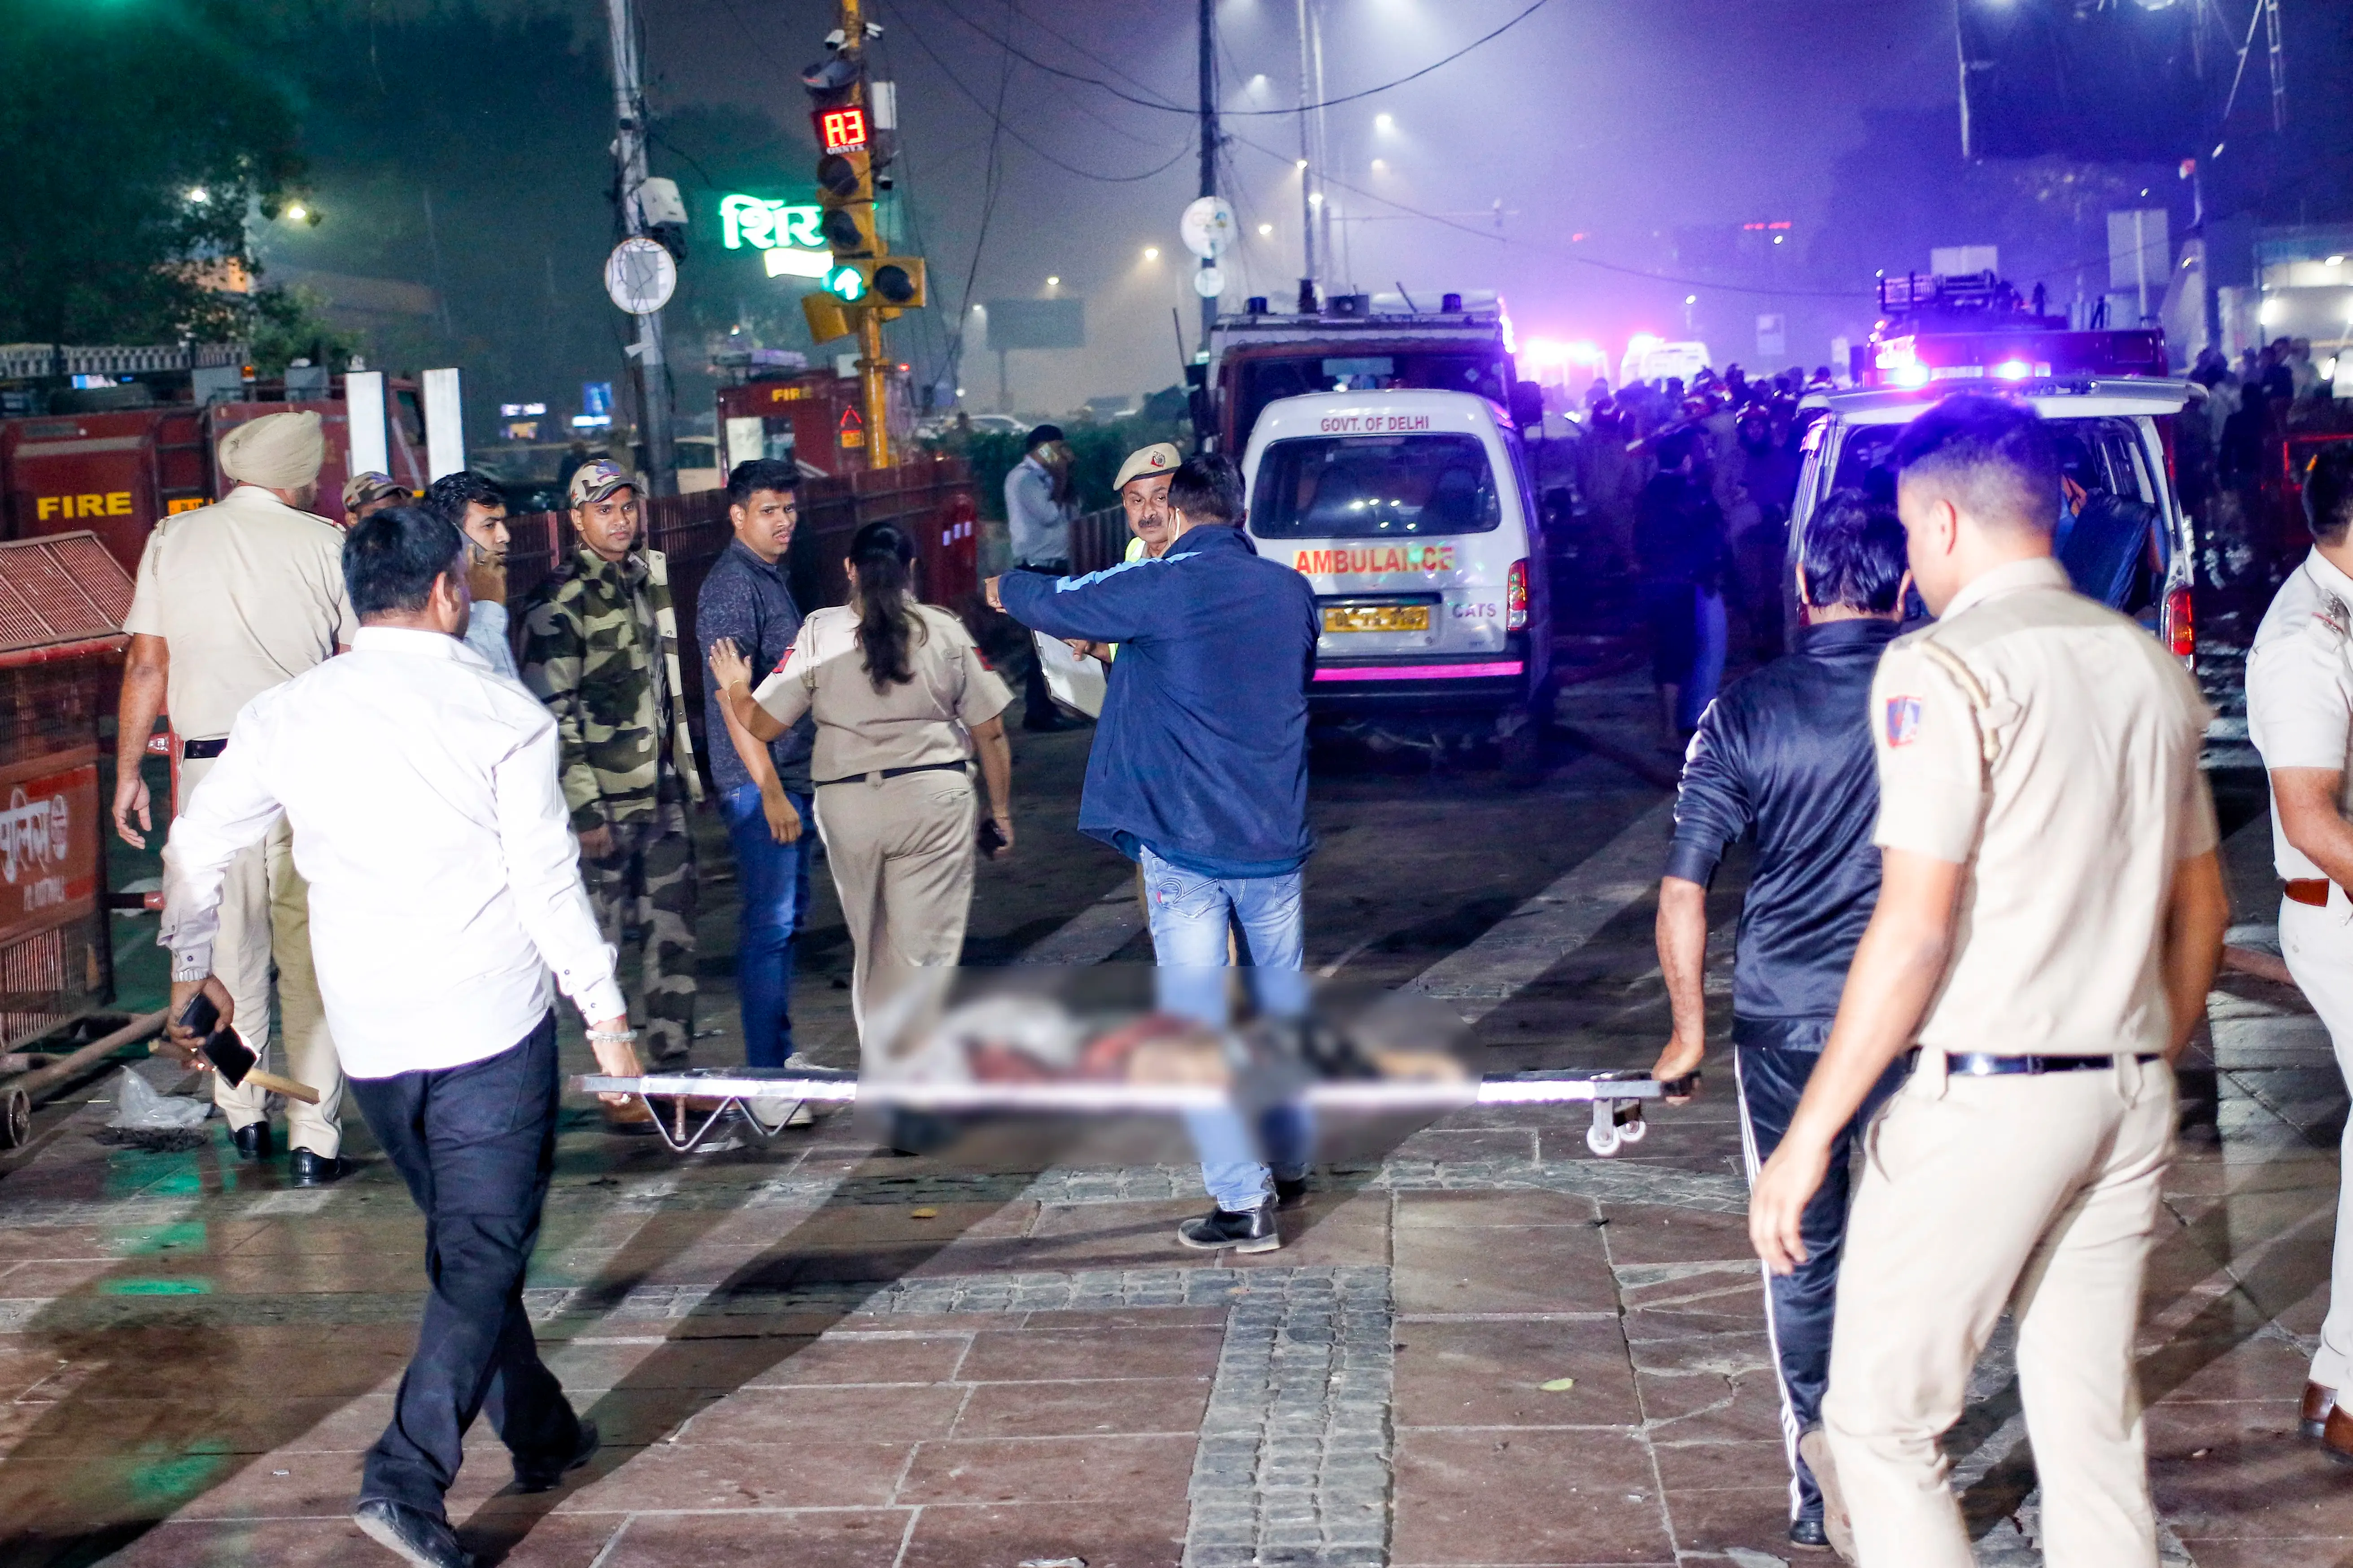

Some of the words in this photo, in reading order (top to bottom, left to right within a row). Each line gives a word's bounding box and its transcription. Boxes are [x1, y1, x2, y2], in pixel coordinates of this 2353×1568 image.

[1320, 417, 1360, 432] GOVT.
[1365, 417, 1383, 431] OF
[1388, 415, 1429, 430] DELHI
[37, 491, 133, 521] FIRE
[1296, 547, 1454, 574] AMBULANCE
[1452, 602, 1497, 618] CATS
